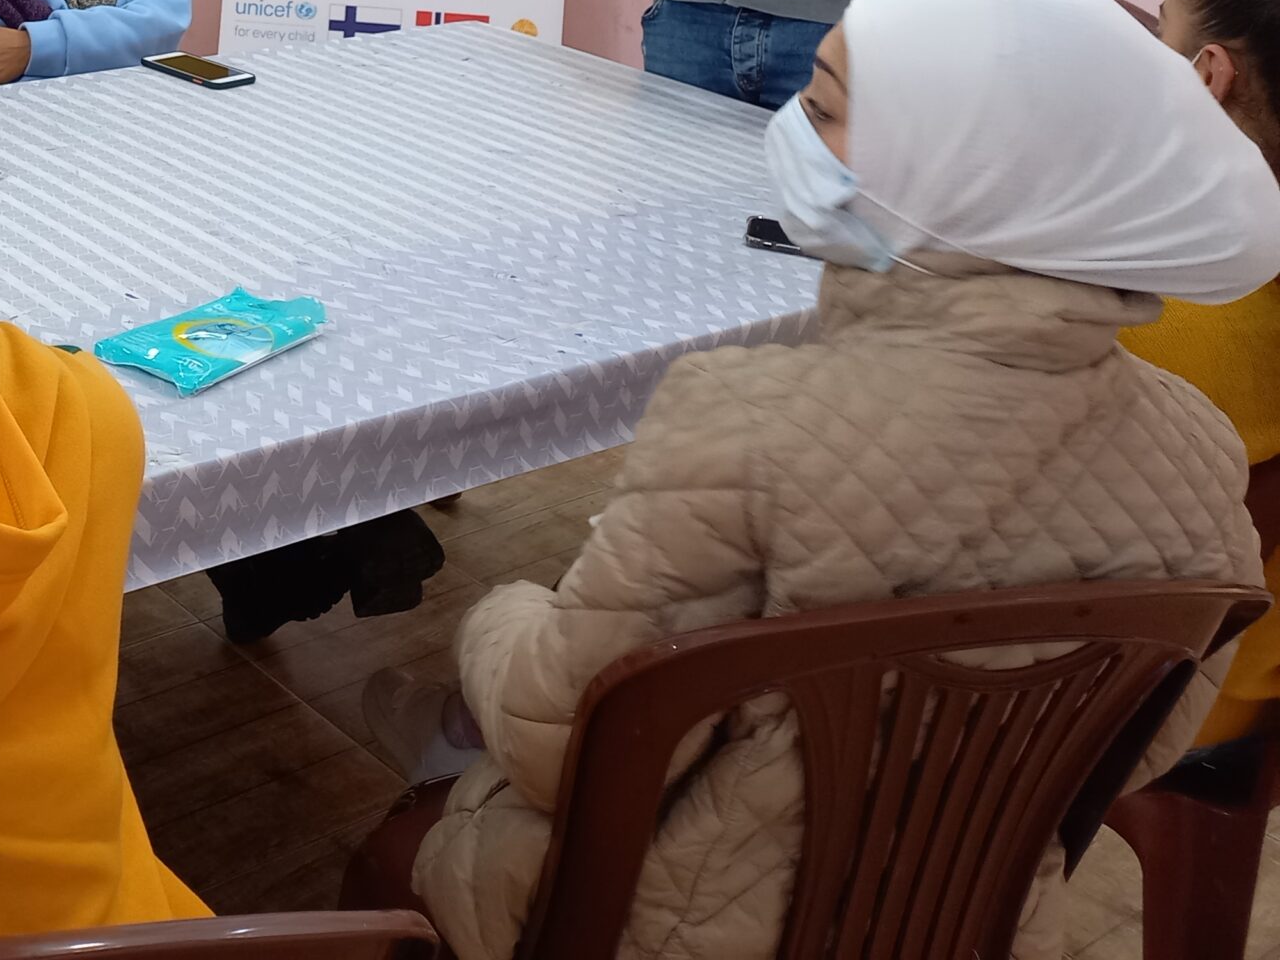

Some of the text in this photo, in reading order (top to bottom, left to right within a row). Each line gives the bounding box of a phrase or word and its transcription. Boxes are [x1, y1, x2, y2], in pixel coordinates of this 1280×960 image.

[234, 25, 315, 42] for every child
